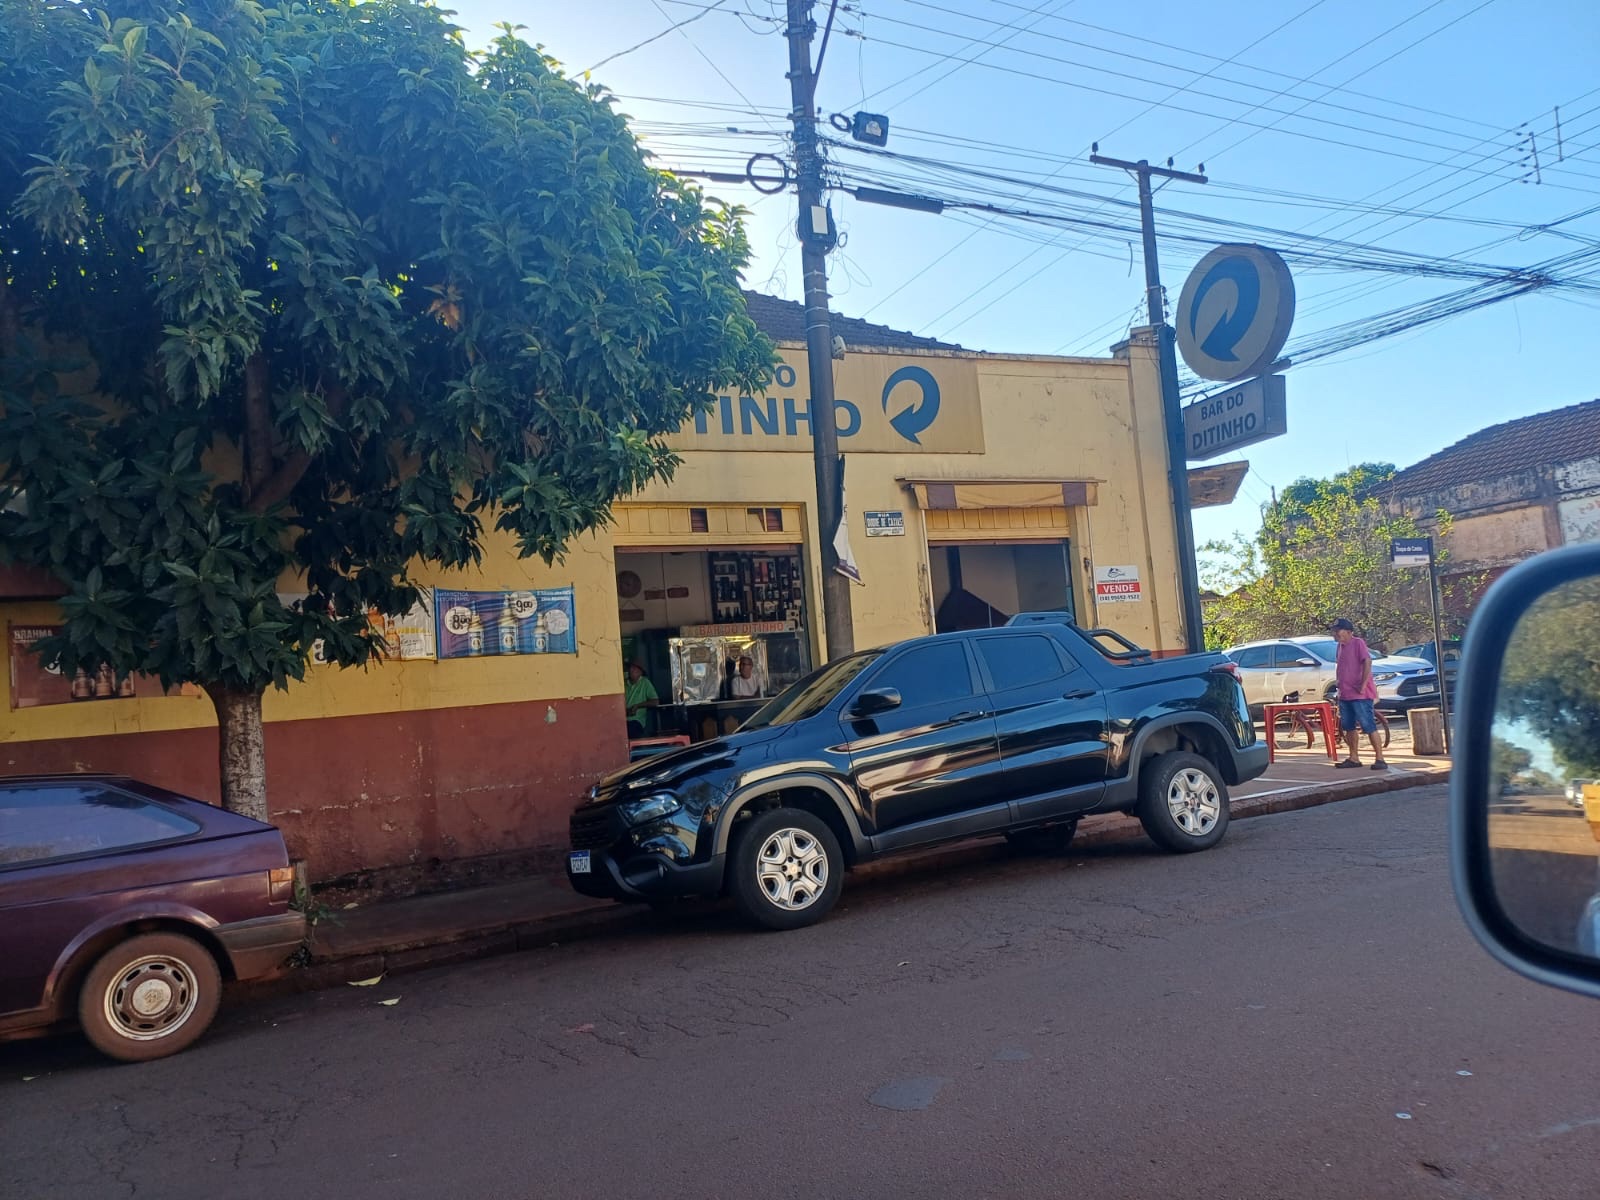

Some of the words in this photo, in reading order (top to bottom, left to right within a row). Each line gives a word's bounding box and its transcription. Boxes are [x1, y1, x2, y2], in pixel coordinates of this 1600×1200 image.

[759, 365, 796, 388] O
[1201, 402, 1223, 420] BAR
[1227, 392, 1244, 410] DO
[1192, 412, 1256, 450] DITINHO
[1103, 584, 1135, 593] VENDE
[14, 629, 53, 640] BRAHMA
[699, 625, 720, 636] BAR
[743, 622, 784, 634] DITINHO
